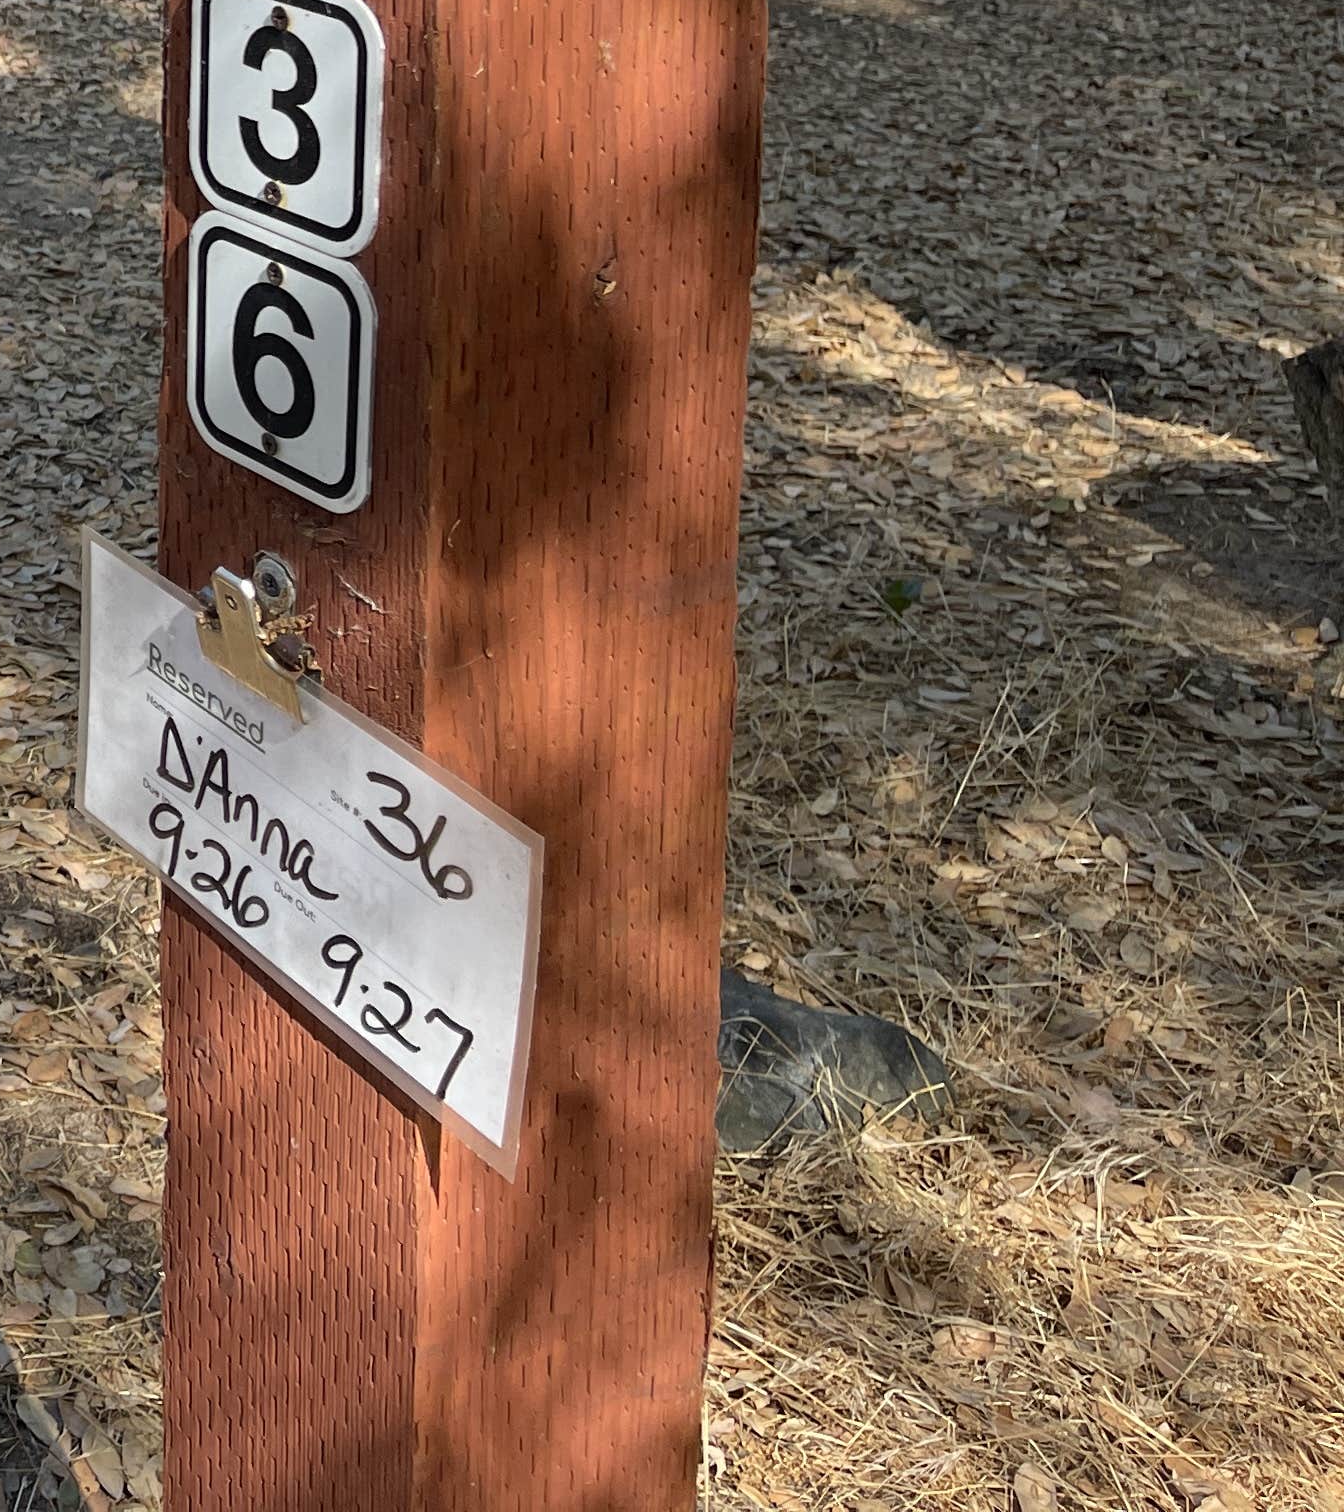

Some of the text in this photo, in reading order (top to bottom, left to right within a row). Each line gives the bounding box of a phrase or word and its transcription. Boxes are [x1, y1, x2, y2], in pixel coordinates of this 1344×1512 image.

[148, 641, 266, 746] Reserved
[156, 716, 340, 902] D'Anna
[363, 770, 475, 901] 36
[273, 880, 293, 904] Due
